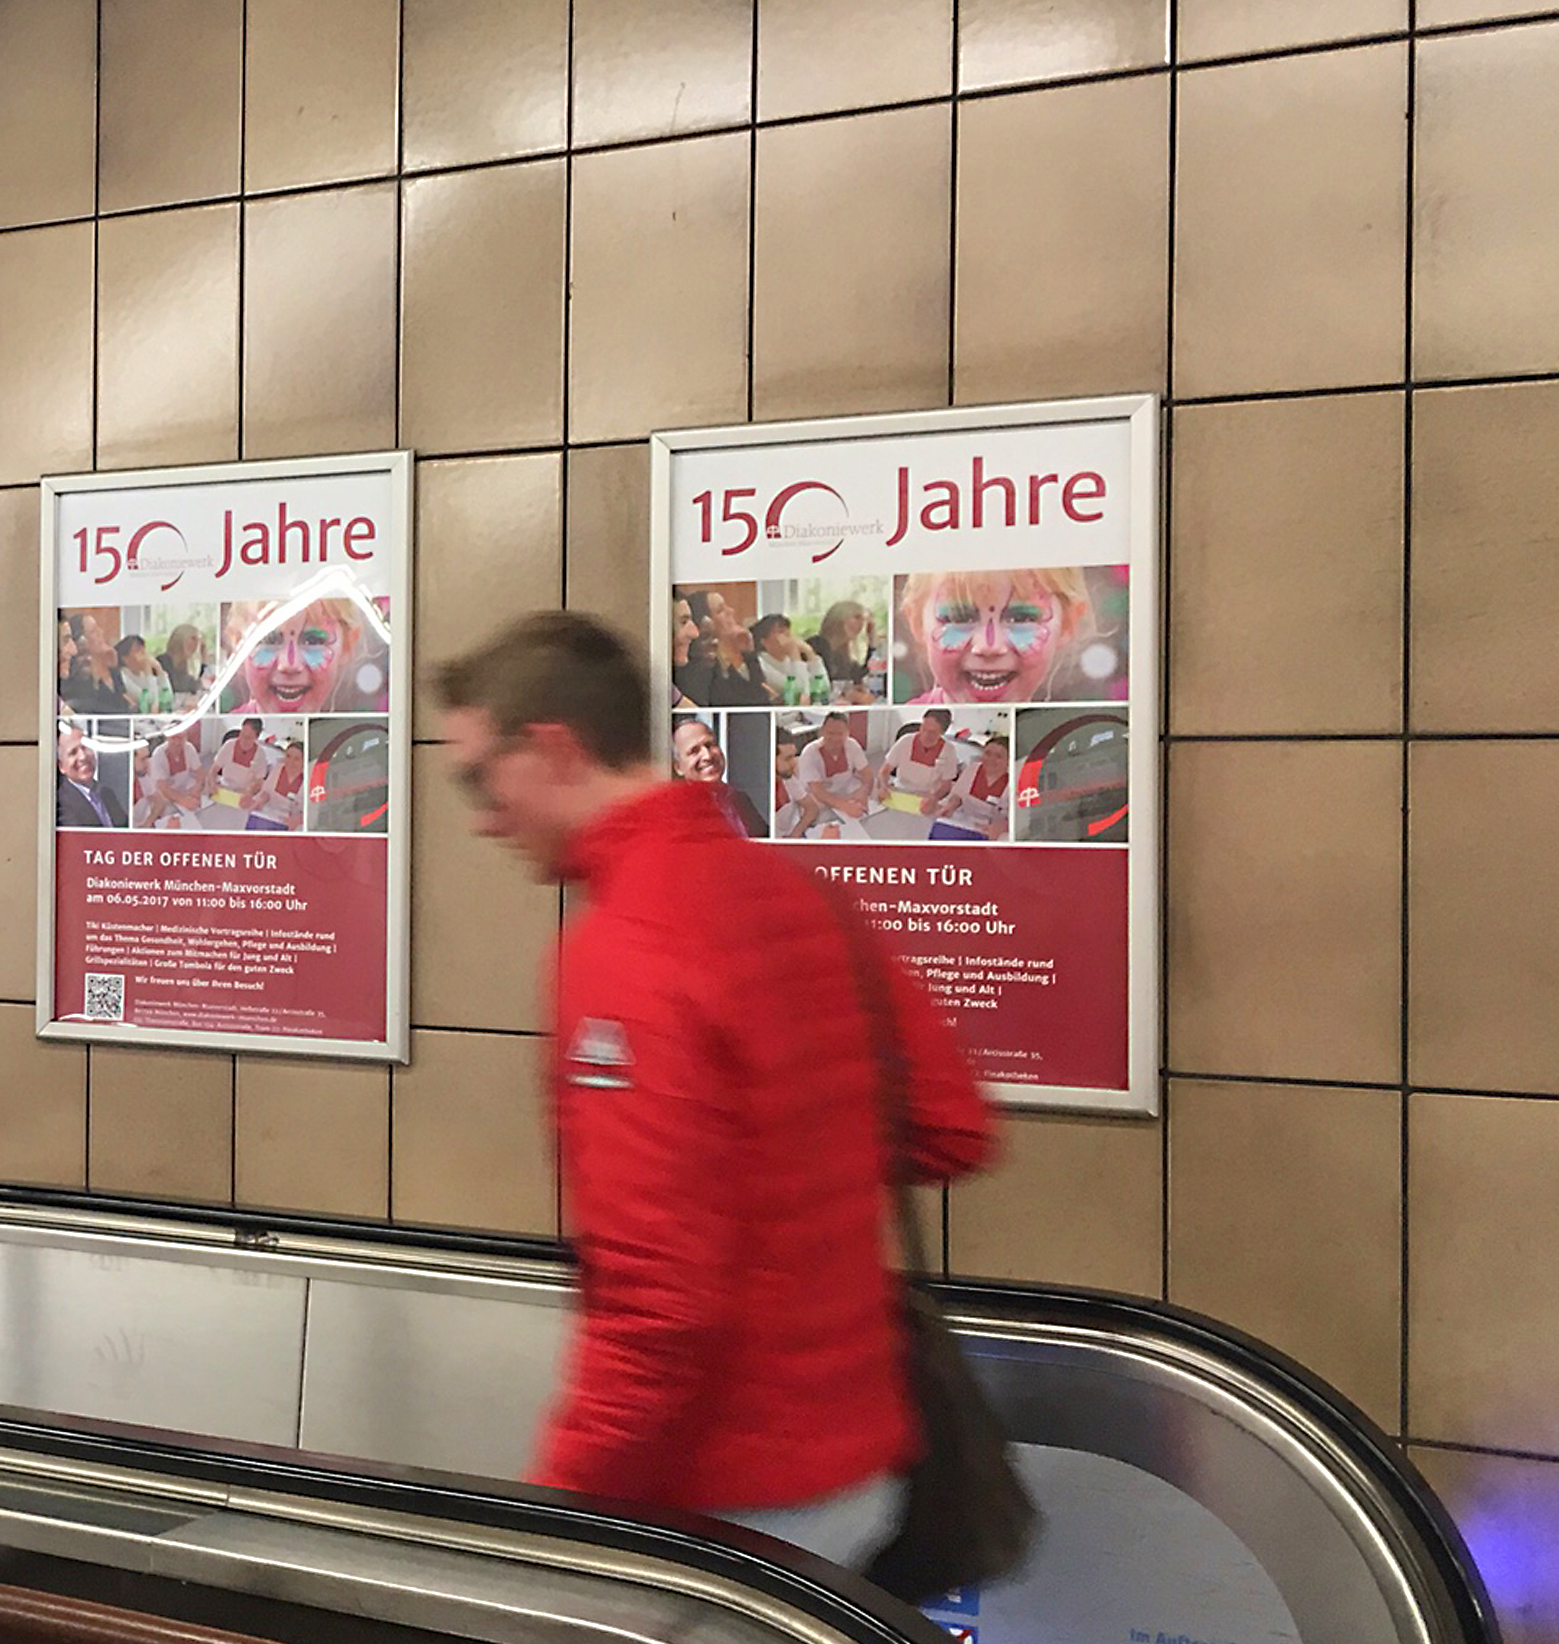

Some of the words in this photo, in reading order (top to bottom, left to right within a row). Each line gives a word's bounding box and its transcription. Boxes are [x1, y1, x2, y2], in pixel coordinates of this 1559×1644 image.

[692, 480, 849, 564] 150
[885, 456, 1107, 547] Jahre
[784, 519, 884, 539] Diakoniewerk
[73, 519, 188, 592] 150
[215, 501, 376, 579] Jahre
[84, 850, 115, 865] TAG
[122, 851, 153, 866] DER
[160, 852, 236, 868] OFFENEN
[243, 851, 277, 870] TÜR
[814, 866, 916, 884] OFFENEN
[926, 865, 973, 886] TÜR
[86, 877, 161, 890] Diakoniewerk
[164, 879, 296, 895] München-Maxvorstadt
[86, 894, 104, 903] am
[106, 893, 169, 908] 06.05.2017
[172, 897, 193, 907] von
[197, 898, 226, 908] 11:00
[229, 896, 246, 909] bis
[250, 898, 282, 910] 16:00
[286, 899, 308, 911] Uhr
[853, 898, 998, 916] hen-Maxvorstadt
[908, 918, 930, 932] bis
[936, 919, 980, 933] 16:00
[986, 920, 1016, 935] Uhr
[965, 956, 1024, 968] Infostände
[1028, 959, 1054, 969] rund
[926, 968, 959, 981] Pflege
[963, 971, 984, 981] und
[987, 971, 1049, 986] Ausbildung
[955, 984, 976, 994] und
[979, 985, 995, 995] Alt
[963, 999, 998, 1009] Zweck
